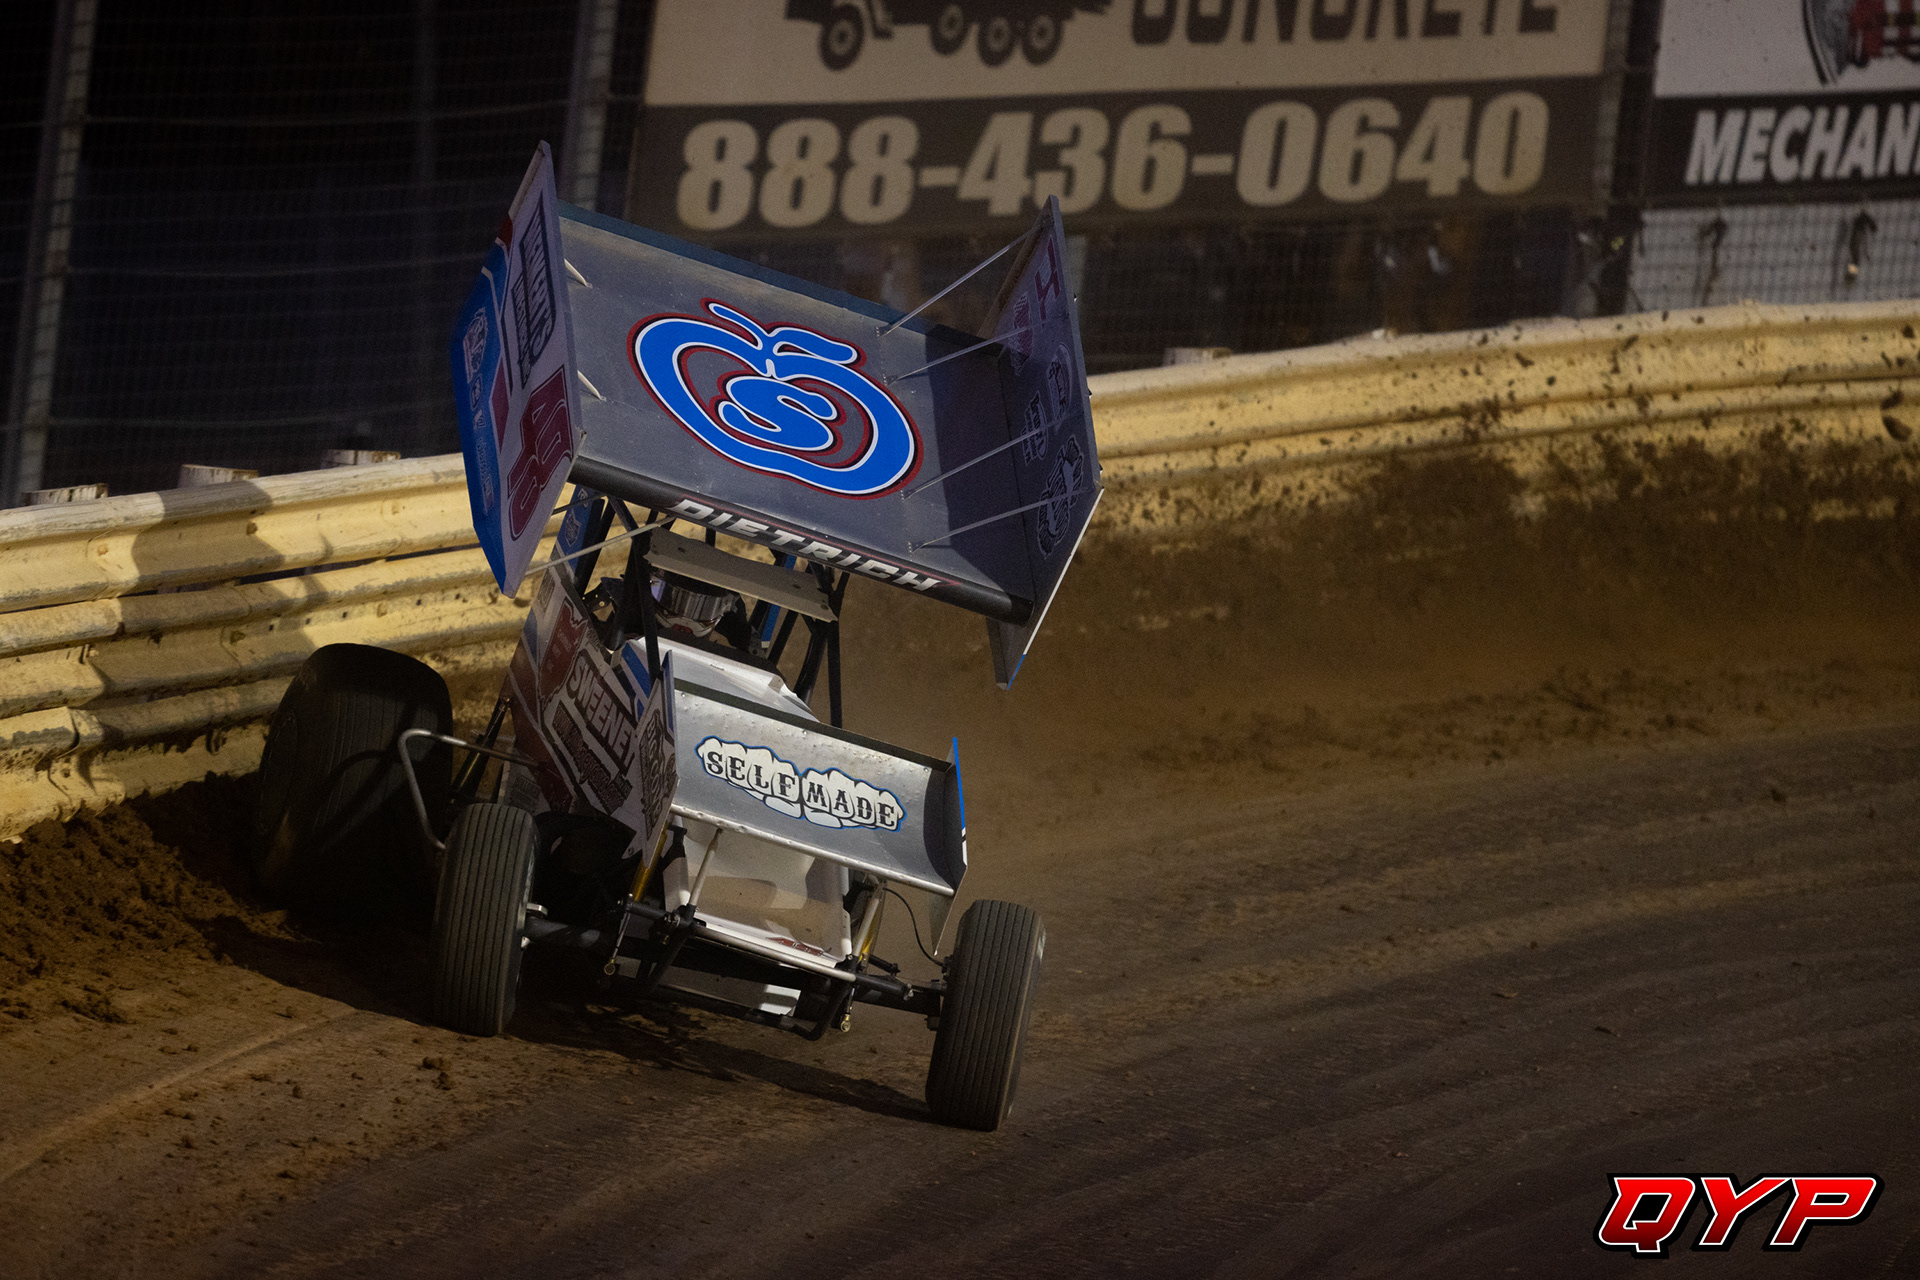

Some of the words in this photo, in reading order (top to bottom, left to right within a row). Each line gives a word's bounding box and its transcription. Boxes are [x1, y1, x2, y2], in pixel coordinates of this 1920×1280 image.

[676, 90, 1551, 231] 888-436-0640
[667, 499, 942, 592] DIETRICH
[567, 653, 639, 772] SWEENEY
[706, 751, 796, 798] SELF
[807, 781, 895, 828] MADE
